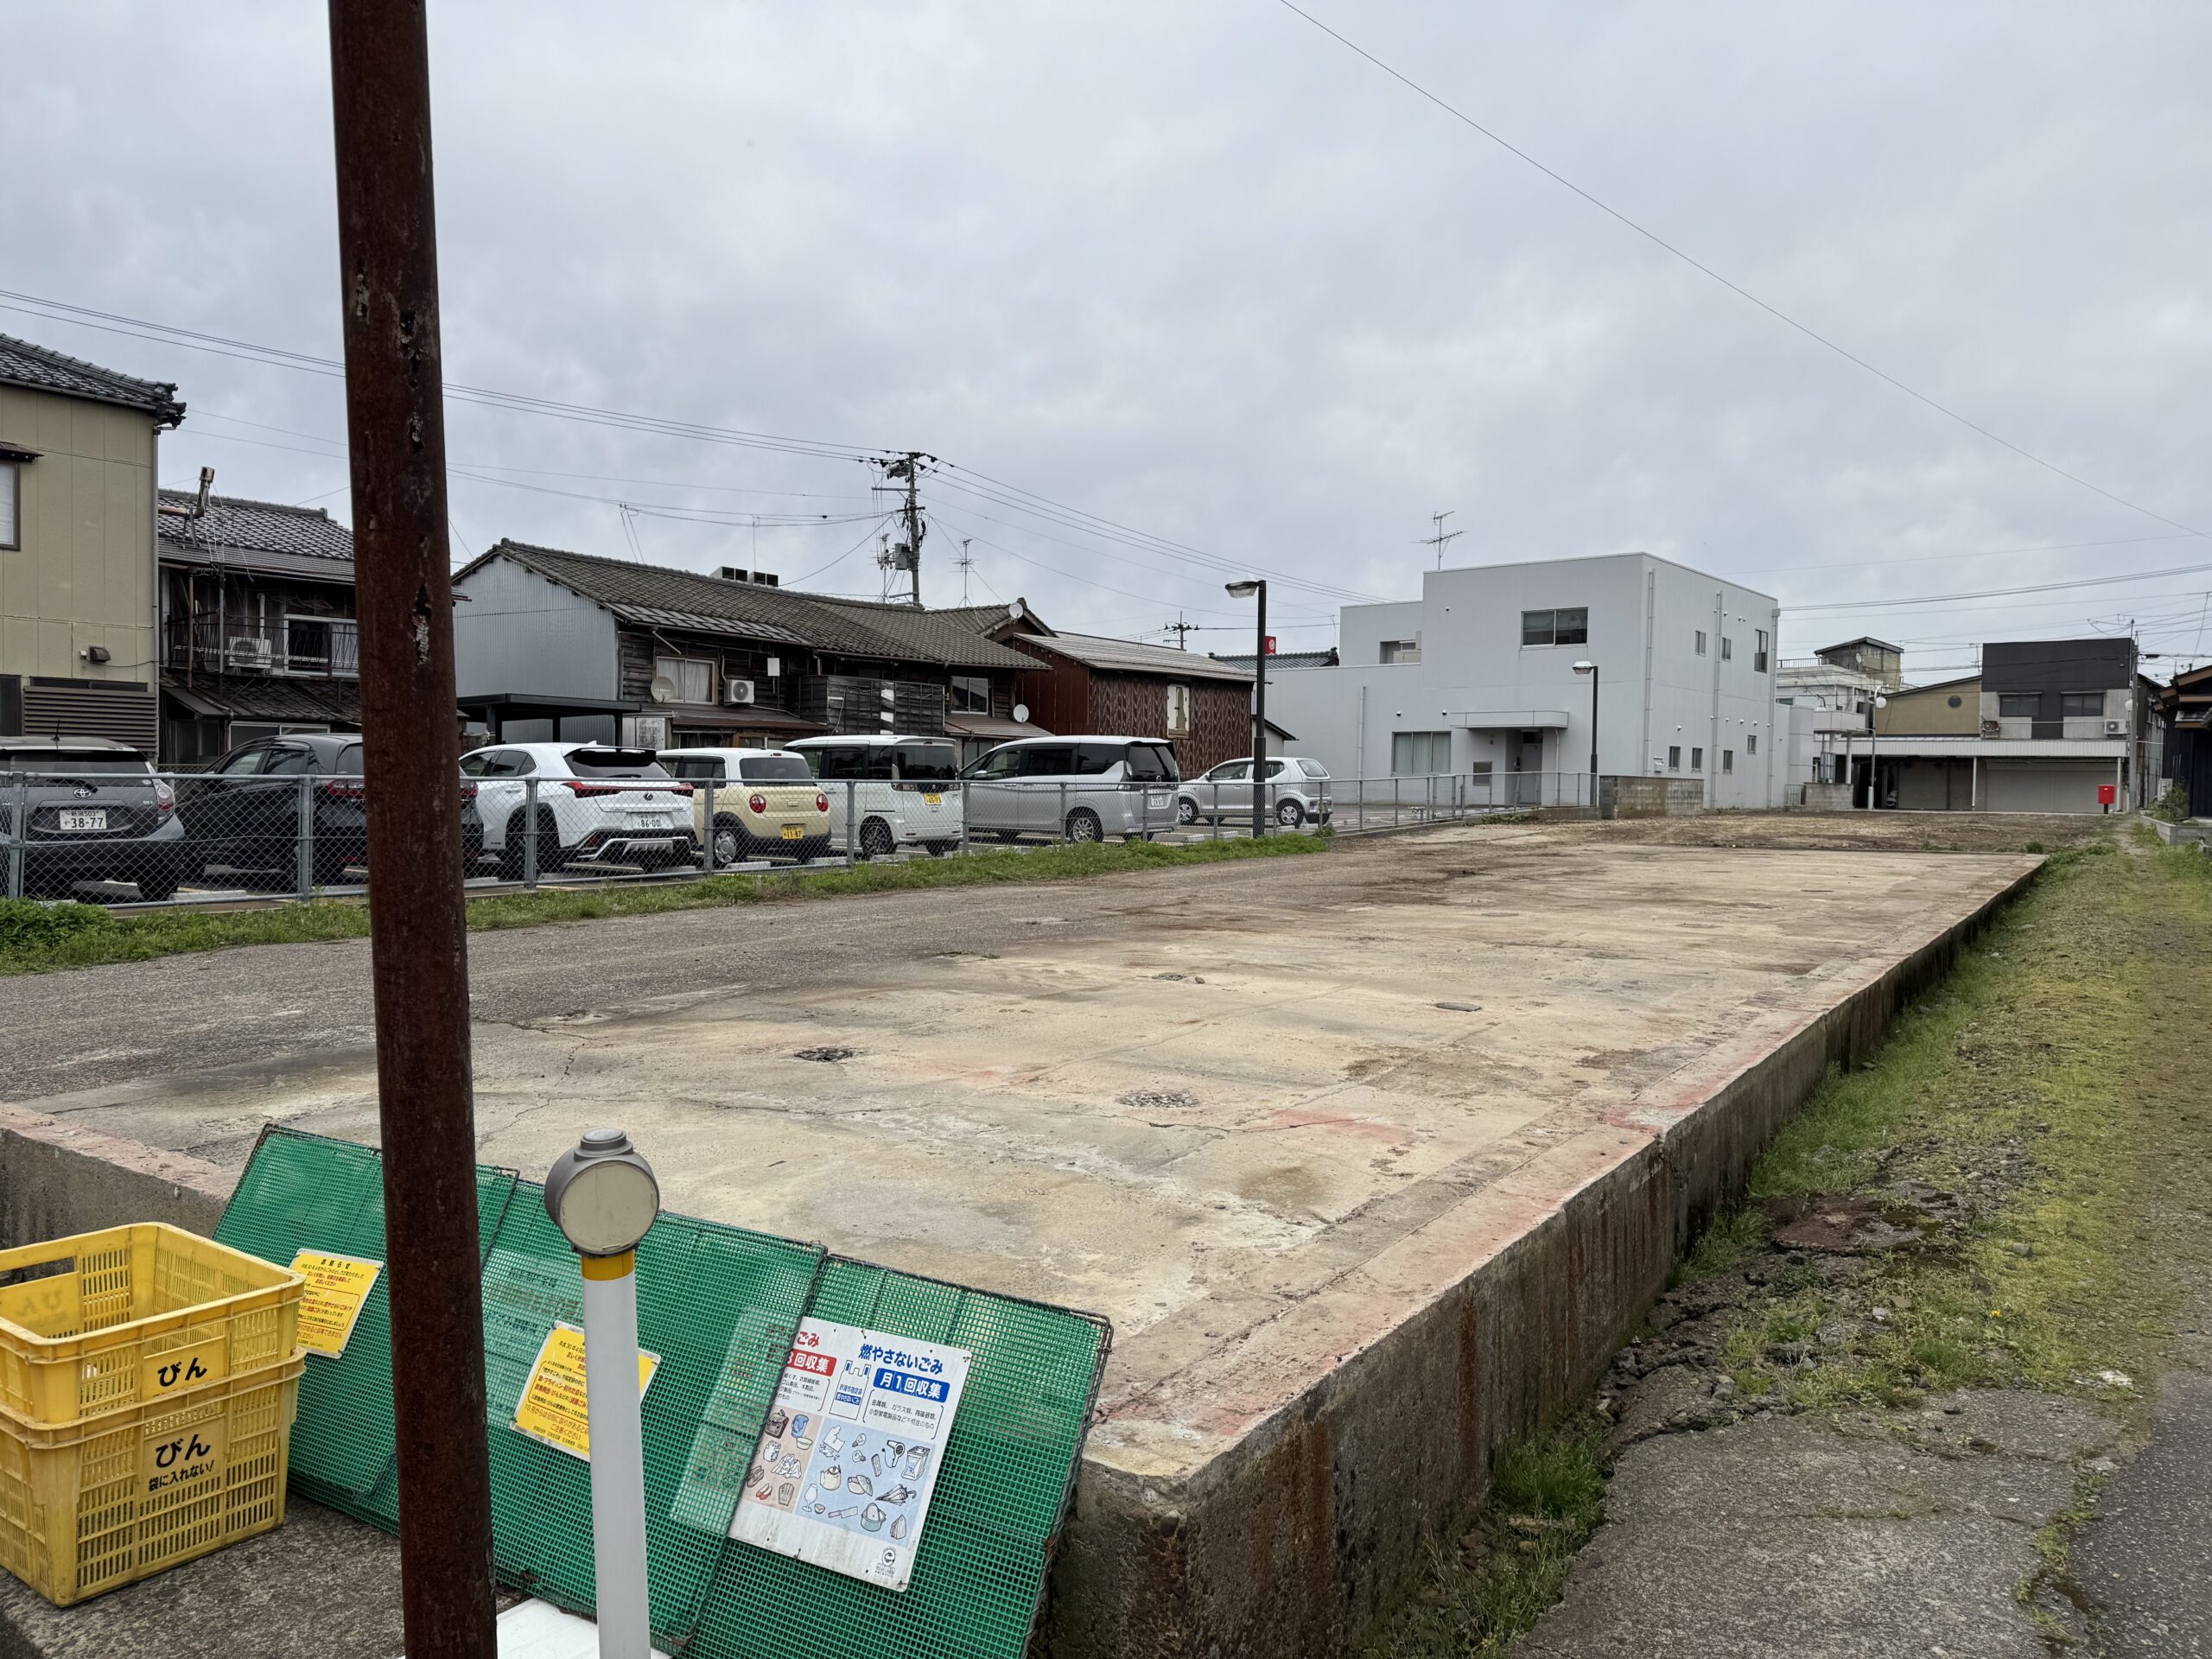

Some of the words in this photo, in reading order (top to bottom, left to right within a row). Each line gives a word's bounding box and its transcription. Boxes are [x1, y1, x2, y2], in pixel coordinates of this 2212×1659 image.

[71, 817, 104, 828] 38-77
[157, 1357, 207, 1387] びん
[857, 1343, 943, 1375] 燃やさないごみ
[880, 1371, 946, 1400] 月1回収集
[156, 1434, 211, 1468] びん
